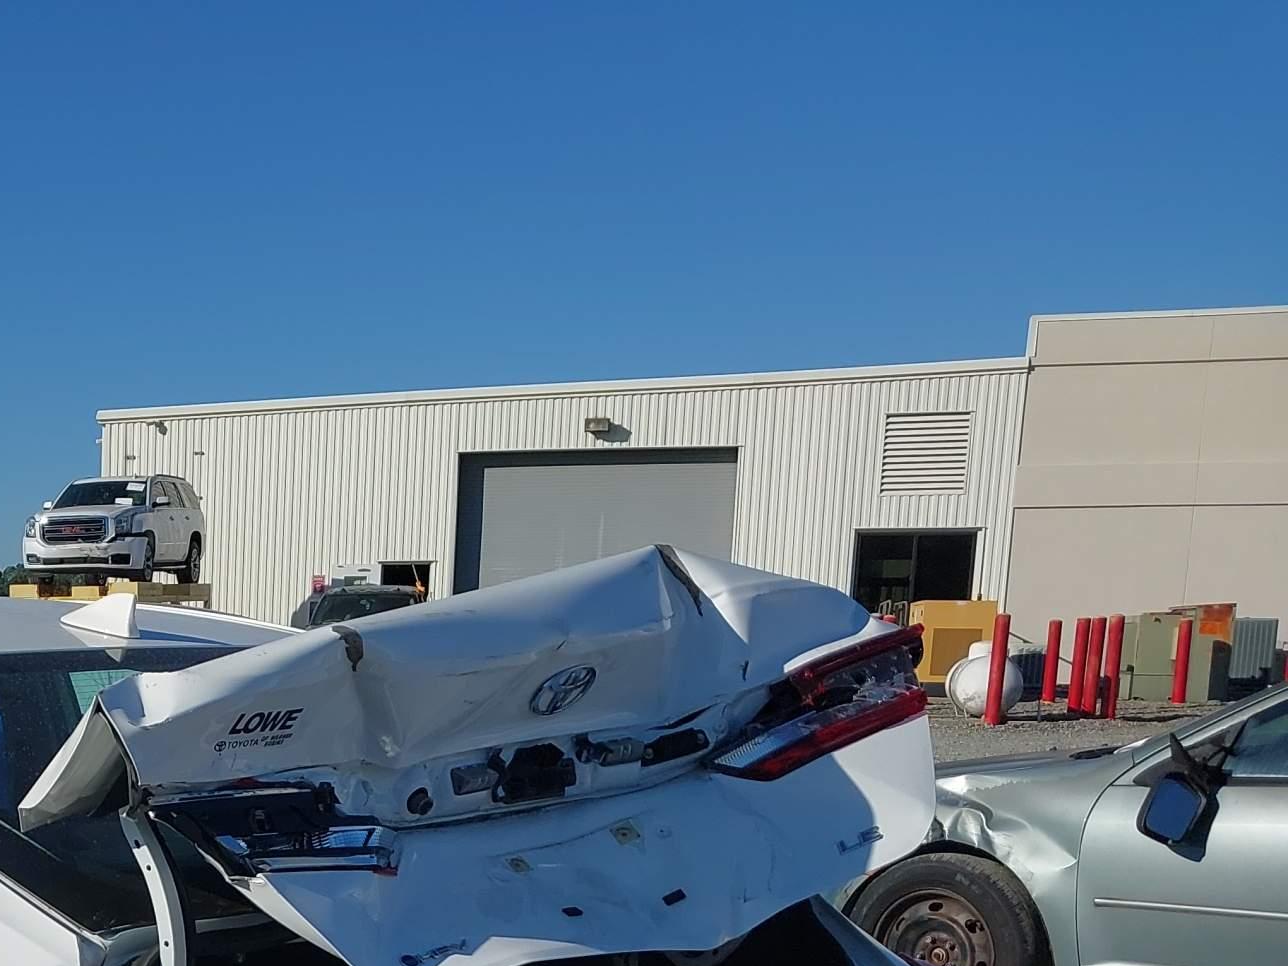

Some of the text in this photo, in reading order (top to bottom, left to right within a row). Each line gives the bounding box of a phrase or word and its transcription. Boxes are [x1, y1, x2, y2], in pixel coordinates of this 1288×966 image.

[228, 708, 304, 735] LOWE
[227, 739, 259, 750] TOYOTA
[837, 825, 884, 856] LE
